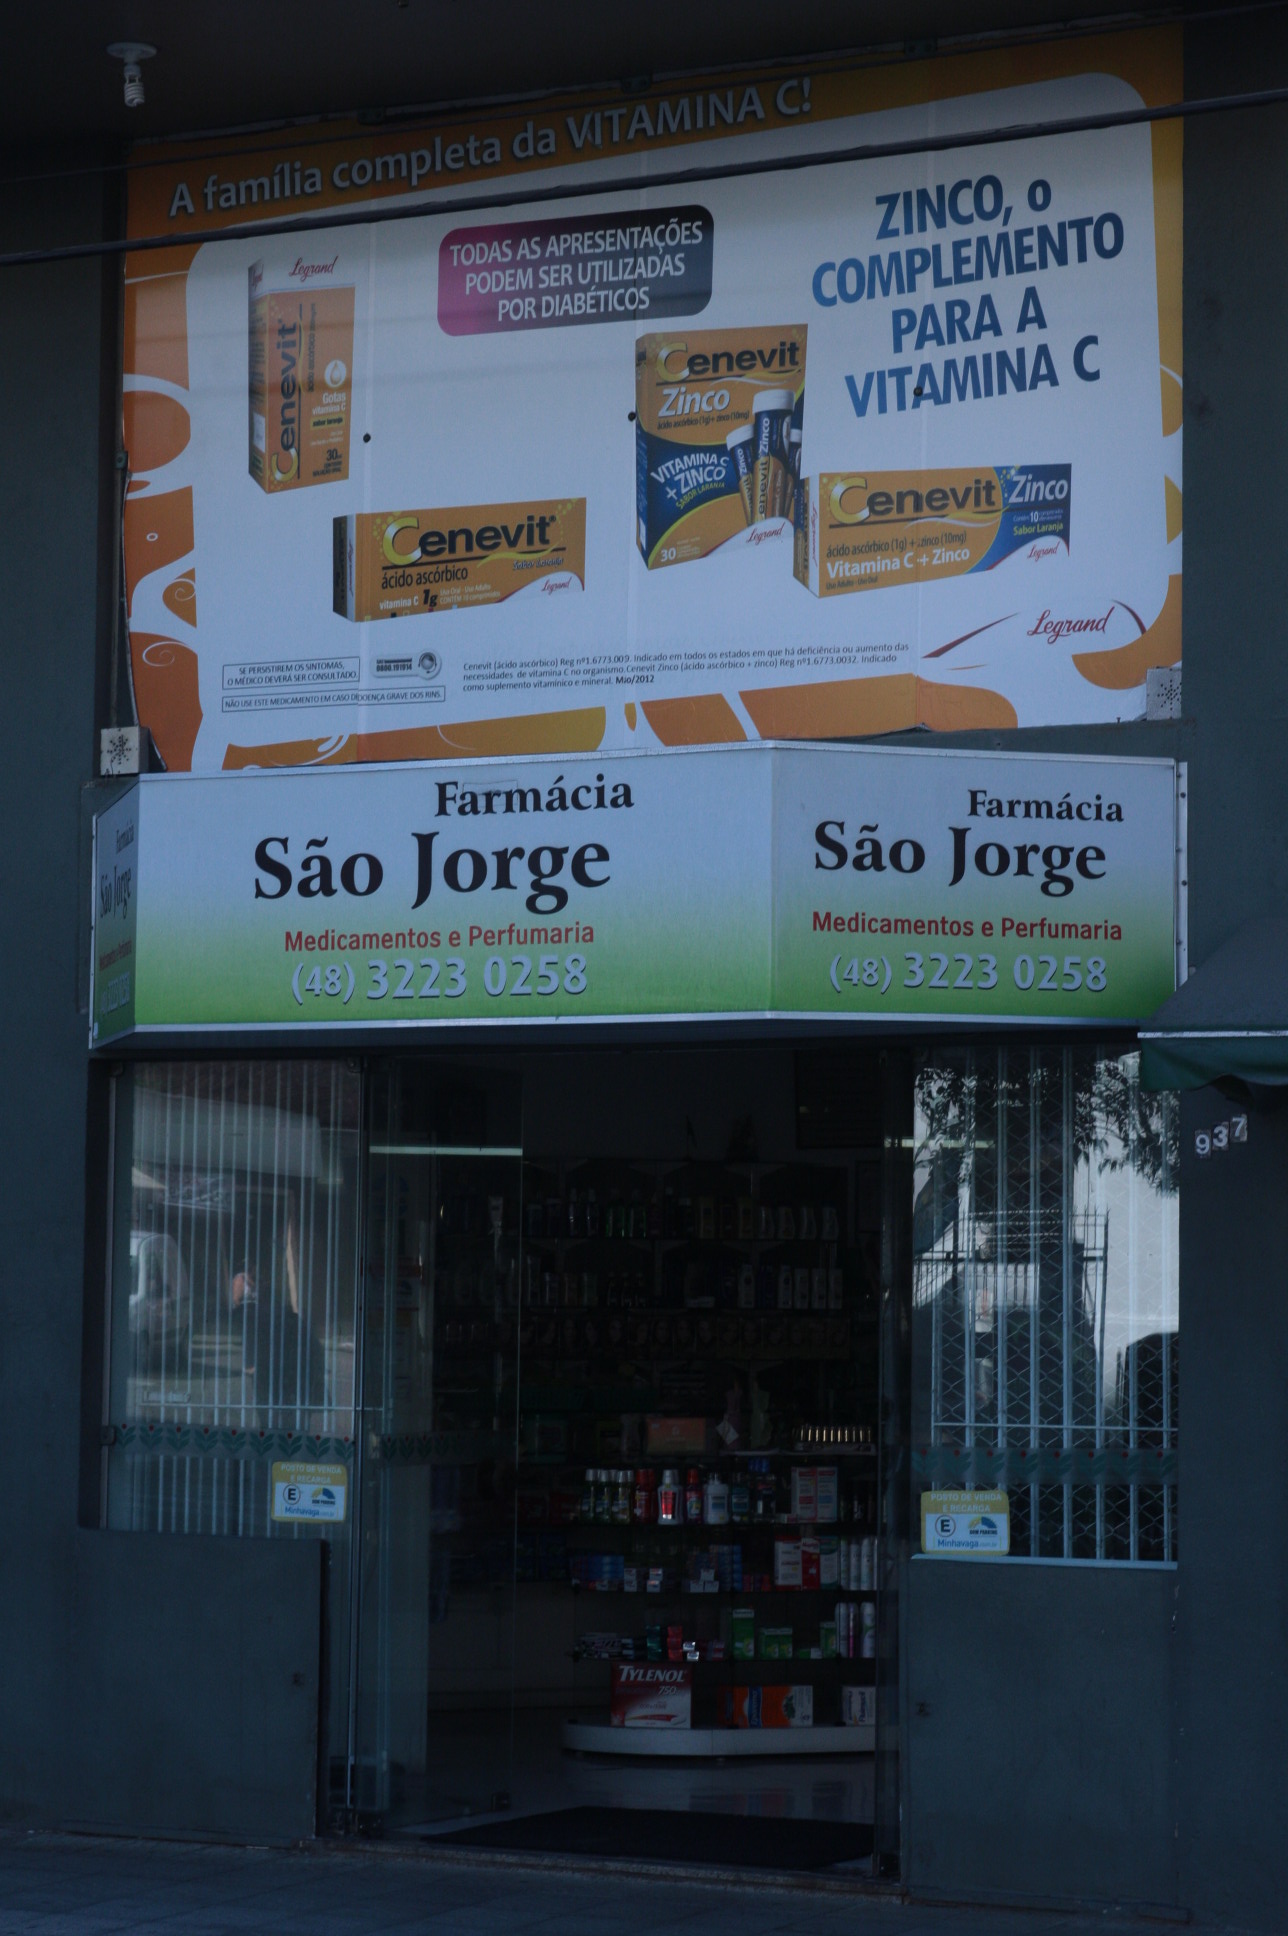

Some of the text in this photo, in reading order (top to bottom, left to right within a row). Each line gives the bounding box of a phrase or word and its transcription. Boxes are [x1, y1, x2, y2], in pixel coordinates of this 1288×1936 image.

[169, 77, 812, 217] A família completa da VITAMINA C!
[875, 174, 1052, 240] ZINCO, o
[450, 217, 703, 267] TODAS AS APRESENTAÇÕES
[288, 255, 339, 282] Legrand
[465, 252, 686, 295] PODEM SER UTILIZADAS
[812, 212, 1124, 307] COMPLEMENTO
[497, 285, 650, 322] POR DIABÉTICOS
[891, 286, 1048, 354] PARA A
[657, 341, 799, 382] Cenevit
[844, 335, 1101, 418] VITAMINA C
[271, 321, 299, 483] Cenevit
[658, 386, 730, 417] Zinco
[760, 417, 771, 454] Zinco
[650, 452, 730, 484] VITAMINA C
[673, 466, 726, 496] ZINCO
[829, 476, 996, 525] Cenevit
[1008, 473, 1069, 504] Zinco
[1013, 521, 1064, 536] Sabor Laranja
[1030, 510, 1039, 523] 10
[382, 514, 552, 566] Cenevit
[746, 521, 783, 545] Legrand
[826, 544, 850, 558] ácido
[852, 539, 890, 556] ascórbico
[891, 536, 907, 551] (1g)
[660, 547, 677, 562] 30
[826, 555, 900, 580] Vitamina
[903, 552, 914, 568] C
[932, 548, 970, 566] Zinco
[381, 566, 469, 589] ácido ascórbico
[379, 597, 412, 611] vitamina
[413, 595, 419, 607] C
[423, 589, 438, 608] 1g
[1027, 605, 1115, 644] Legrand
[248, 664, 293, 675] PERSISTIREM
[294, 664, 304, 672] OS
[463, 662, 492, 671] Cenevit
[494, 661, 518, 671] (ácido
[519, 658, 558, 669] ascórbico)
[560, 658, 575, 668] Reg
[634, 652, 667, 663] Indicado
[669, 654, 682, 662] em
[684, 651, 706, 660] todos
[708, 652, 718, 660] os
[720, 649, 750, 659] estados
[752, 650, 766, 658] em
[767, 649, 783, 659] que
[784, 647, 795, 657] há
[797, 645, 840, 656] deficiência
[842, 646, 853, 654] ou
[855, 644, 892, 654] aumento
[894, 643, 909, 651] das
[463, 671, 513, 681] necessidades
[517, 670, 527, 679] de
[528, 669, 562, 679] vitamina
[563, 668, 569, 676] C
[658, 662, 679, 672] Zinco
[680, 660, 705, 672] (ácido
[706, 659, 745, 670] ascórbico
[754, 659, 778, 669] zinco)
[779, 658, 795, 669] Reg
[861, 654, 897, 664] Indicado
[227, 678, 233, 686] O
[234, 675, 264, 686] MÉDICO
[264, 673, 293, 684] DEVERÁ
[293, 673, 307, 682] SER
[463, 684, 484, 692] como
[485, 681, 531, 692] suplemento
[225, 700, 240, 708] NÃO
[409, 691, 424, 699] DOS
[433, 773, 635, 817] Farmácia
[967, 789, 1125, 822] Farmácia
[254, 831, 611, 915] São Jorge
[814, 821, 1107, 897] São Jorge
[113, 866, 132, 920] Jorge
[284, 921, 594, 952] Medicamentos e Perfumaria
[812, 911, 1123, 941] Medicamentos e Perfumaria
[290, 952, 588, 1005] (48) 3223 0258
[829, 952, 1108, 994] (48) 3223 0258
[1195, 1115, 1246, 1155] 937
[288, 1488, 296, 1500] E
[940, 1519, 950, 1532] E
[618, 1665, 685, 1682] TYLENOL
